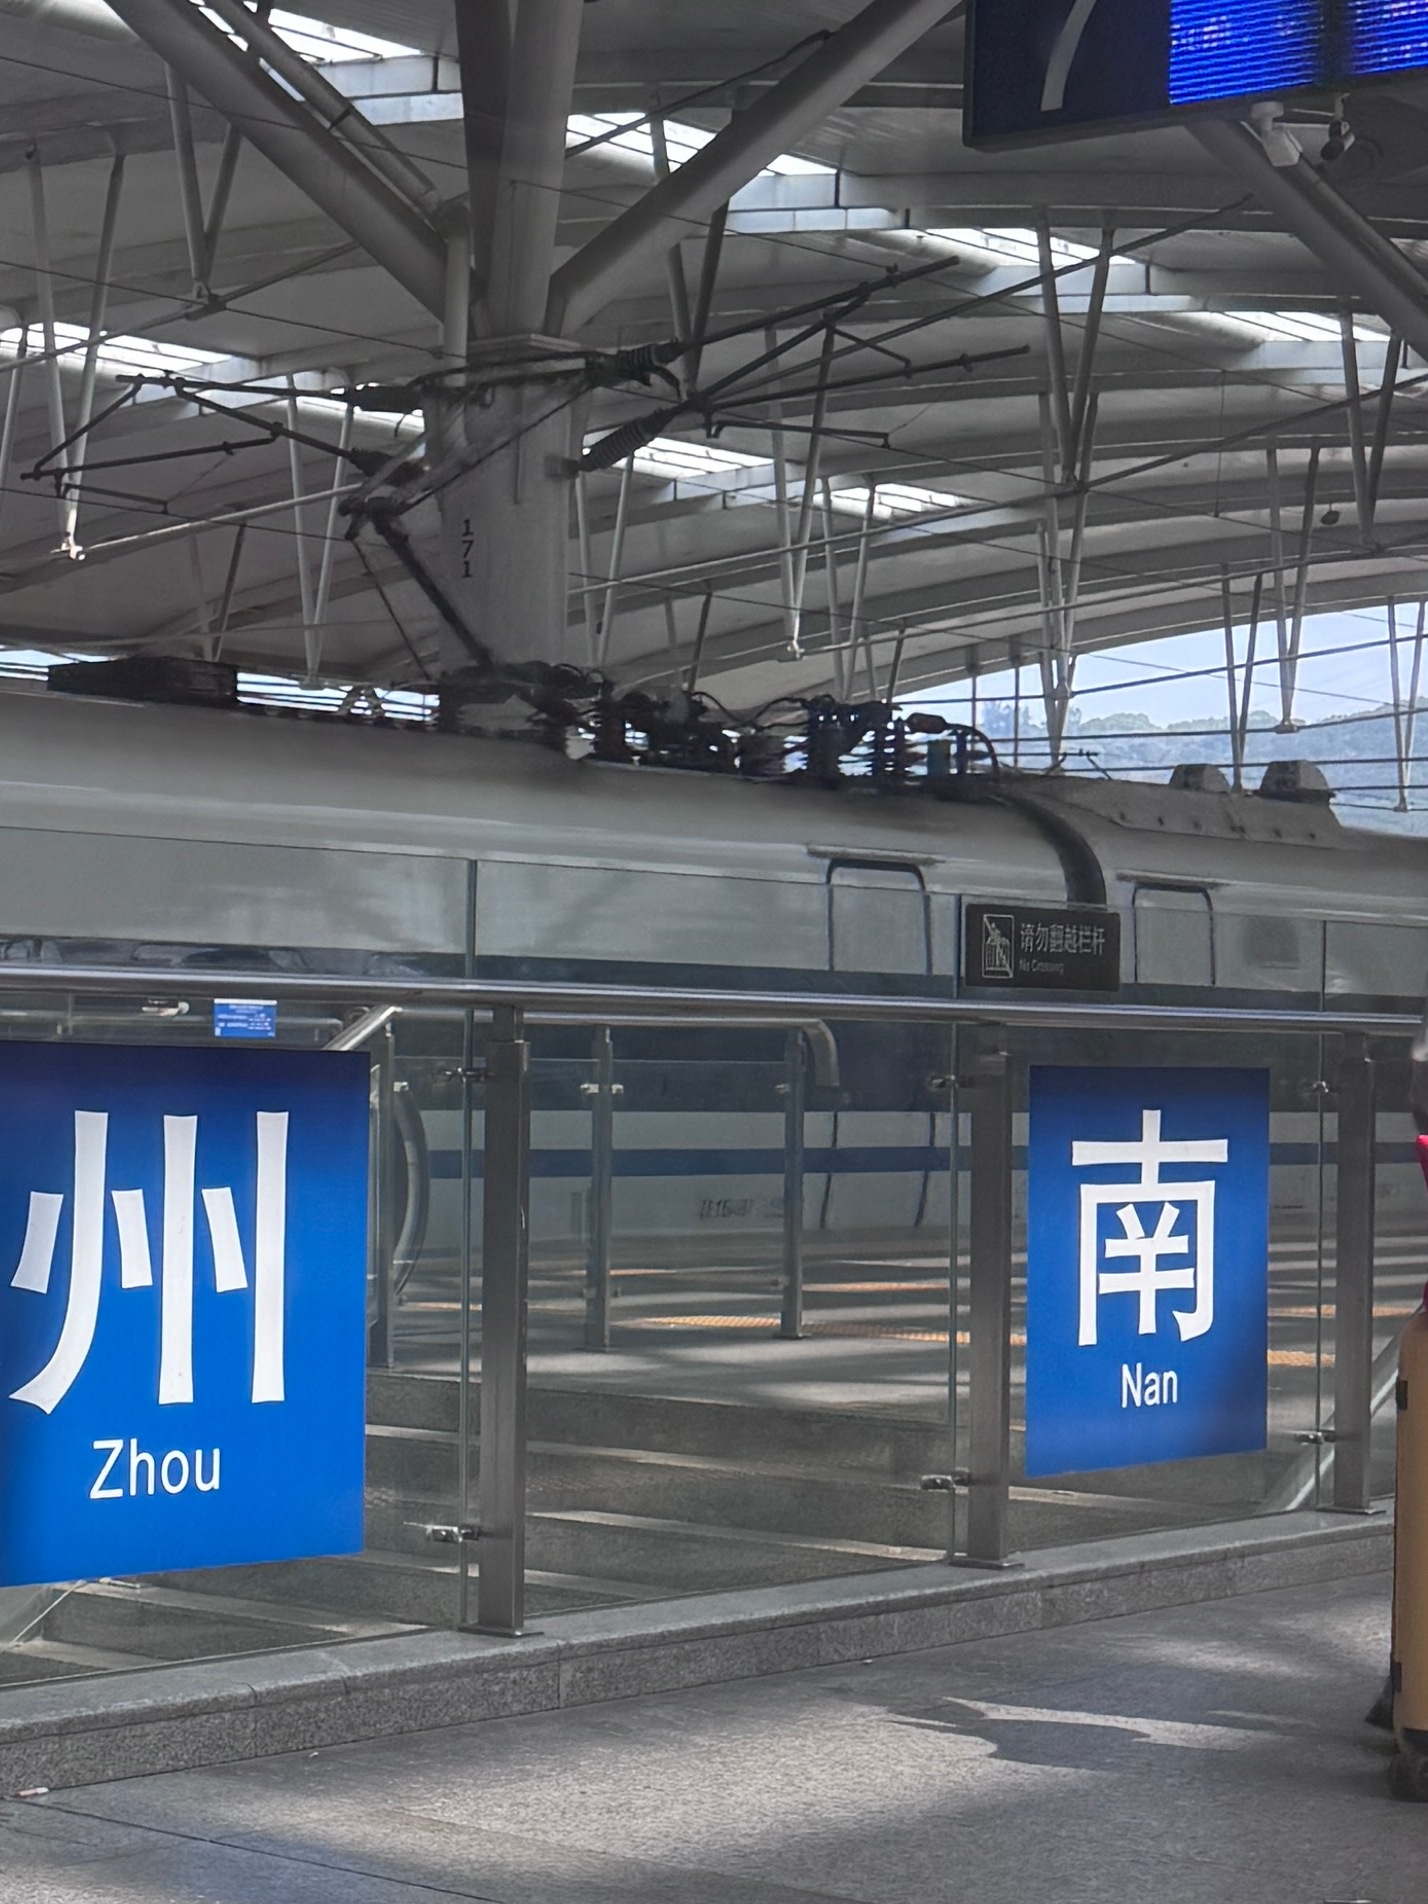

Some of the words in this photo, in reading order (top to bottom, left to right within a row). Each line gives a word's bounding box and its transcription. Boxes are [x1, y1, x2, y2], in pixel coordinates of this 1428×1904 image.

[462, 518, 474, 578] 171
[1020, 922, 1106, 956] 请勿翻越栏杆
[1071, 1109, 1228, 1346] 南
[9, 1110, 289, 1415] 州
[1121, 1362, 1178, 1409] Nan
[89, 1438, 221, 1499] Zhou
